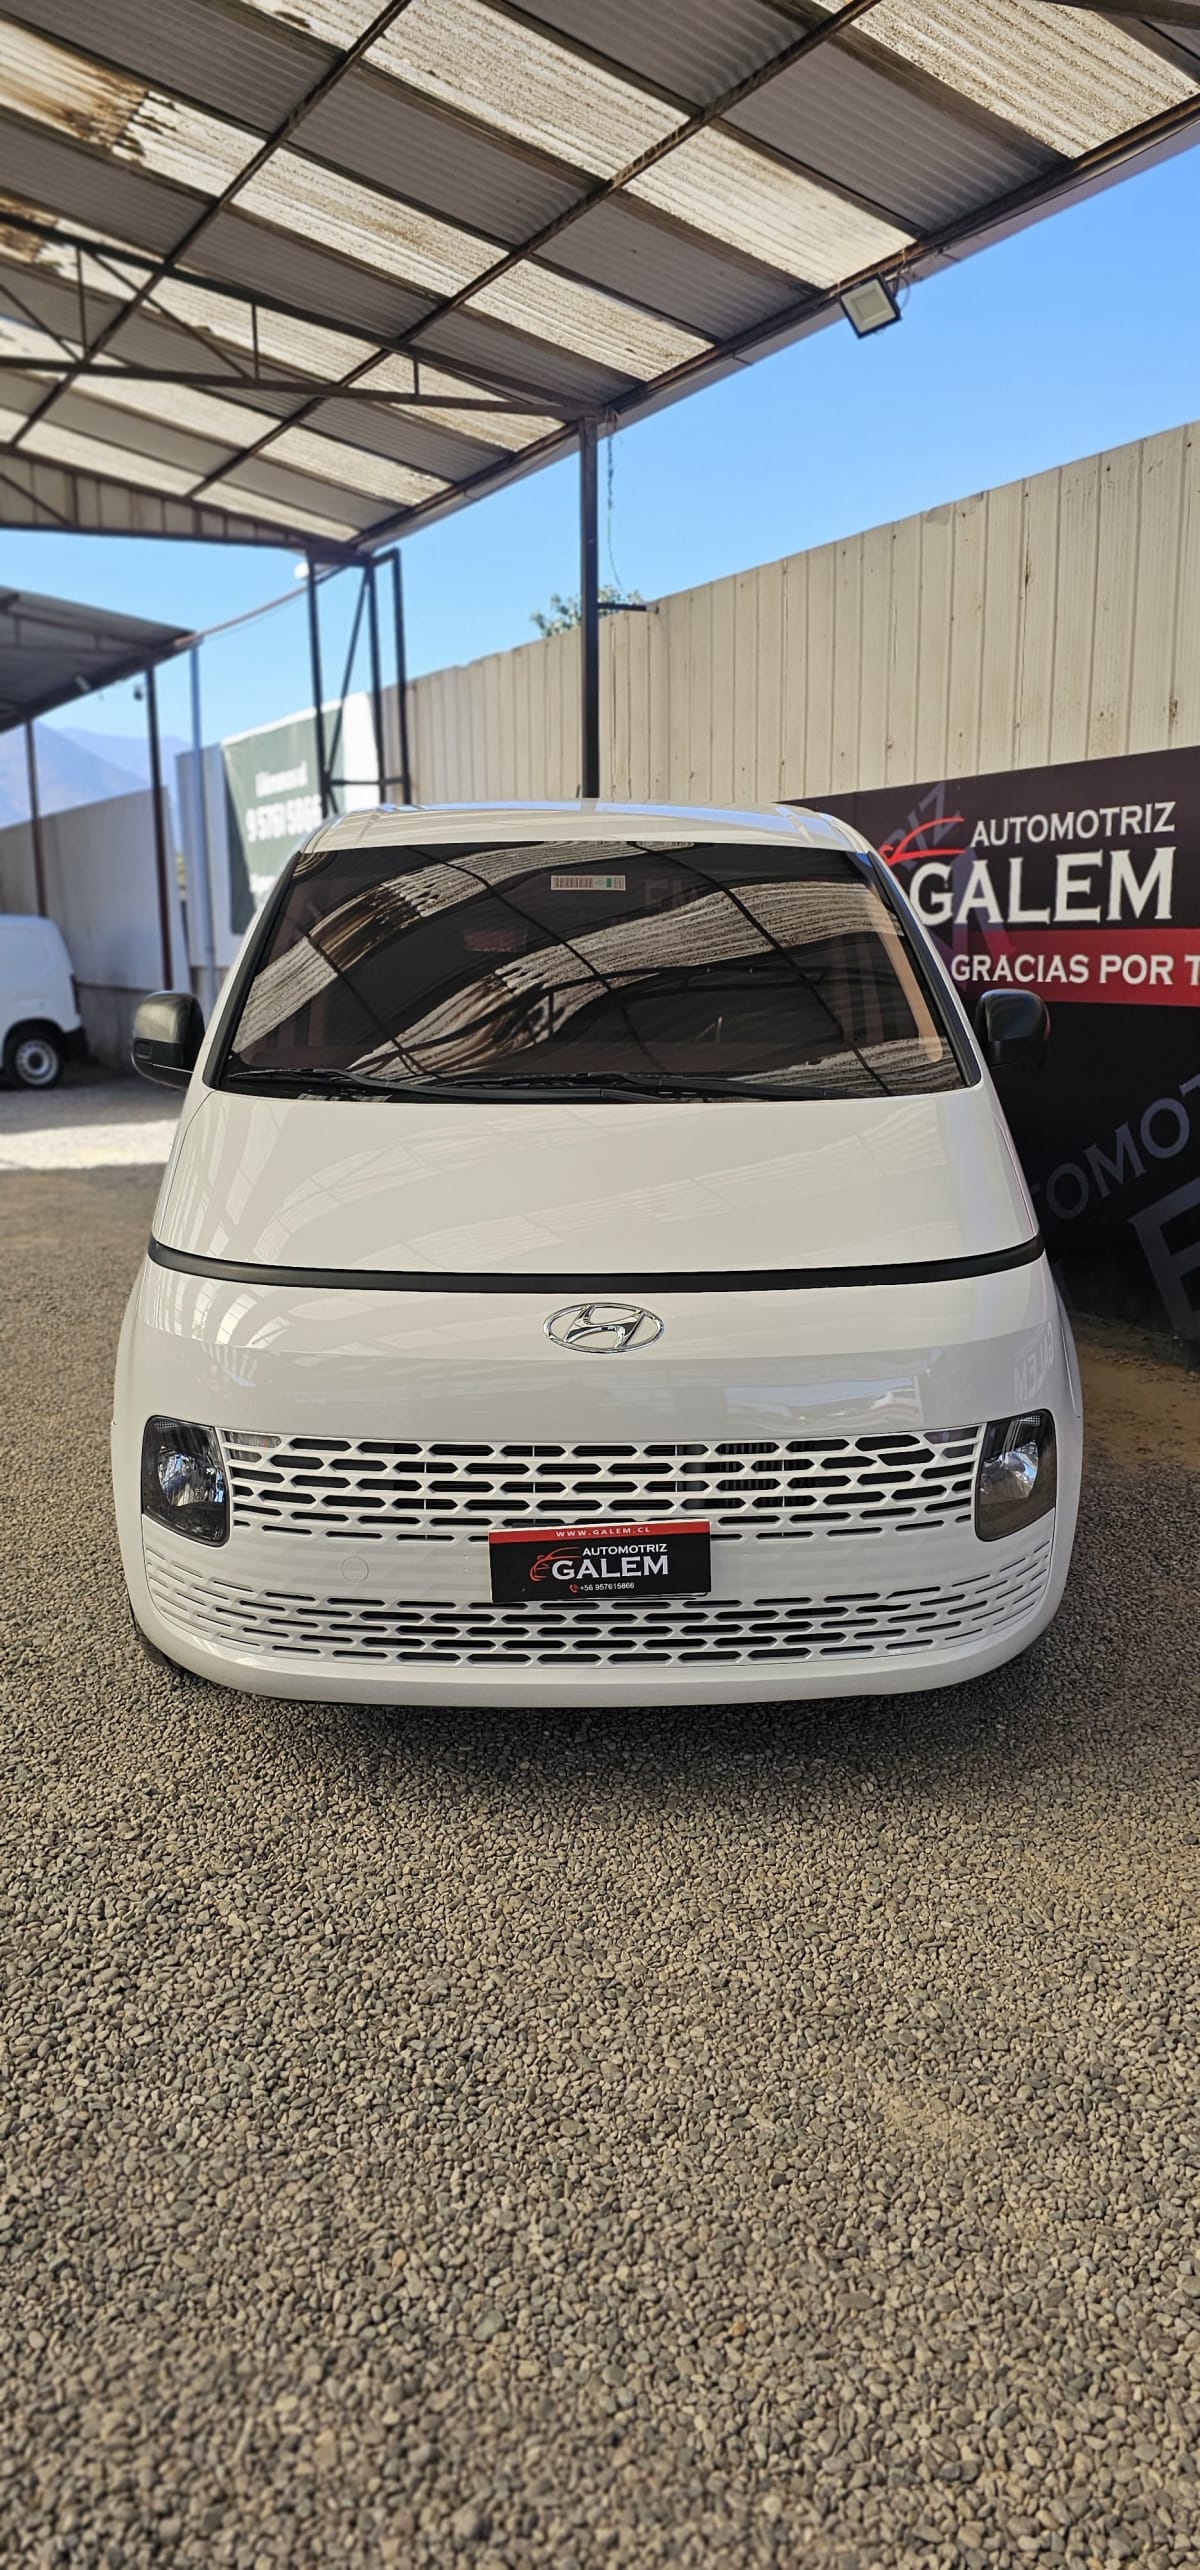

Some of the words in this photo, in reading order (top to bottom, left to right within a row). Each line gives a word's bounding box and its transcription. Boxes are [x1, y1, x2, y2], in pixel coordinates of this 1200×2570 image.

[970, 801, 1176, 848] AUTOMOTRIZ
[909, 846, 1176, 926] GALEM
[951, 954, 1089, 983] GRACIAS
[1099, 953, 1174, 985] POR
[556, 1526, 651, 1537] WWW.GALEM.CL
[582, 1543, 668, 1556] AUTOMOTRIZ
[551, 1555, 669, 1580] GALEM
